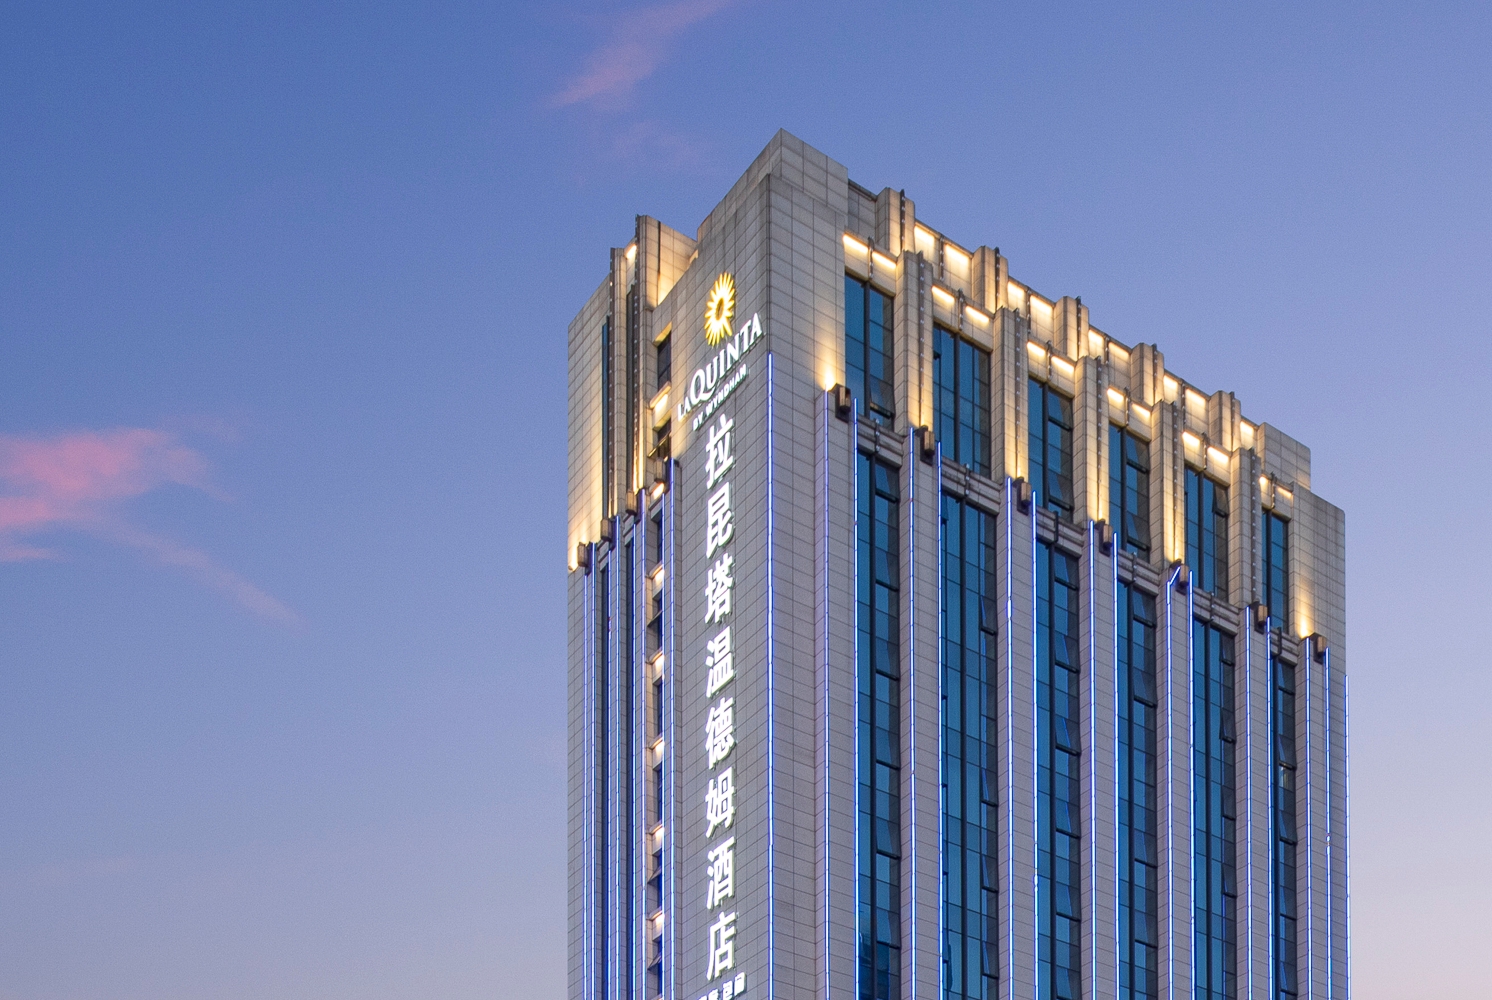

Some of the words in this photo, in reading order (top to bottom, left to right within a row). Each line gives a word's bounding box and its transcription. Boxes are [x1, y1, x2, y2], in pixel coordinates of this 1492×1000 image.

[693, 411, 704, 431] BY
[705, 363, 747, 417] WYNDHAM
[704, 413, 736, 981] 拉昆塔温德姆酒店
